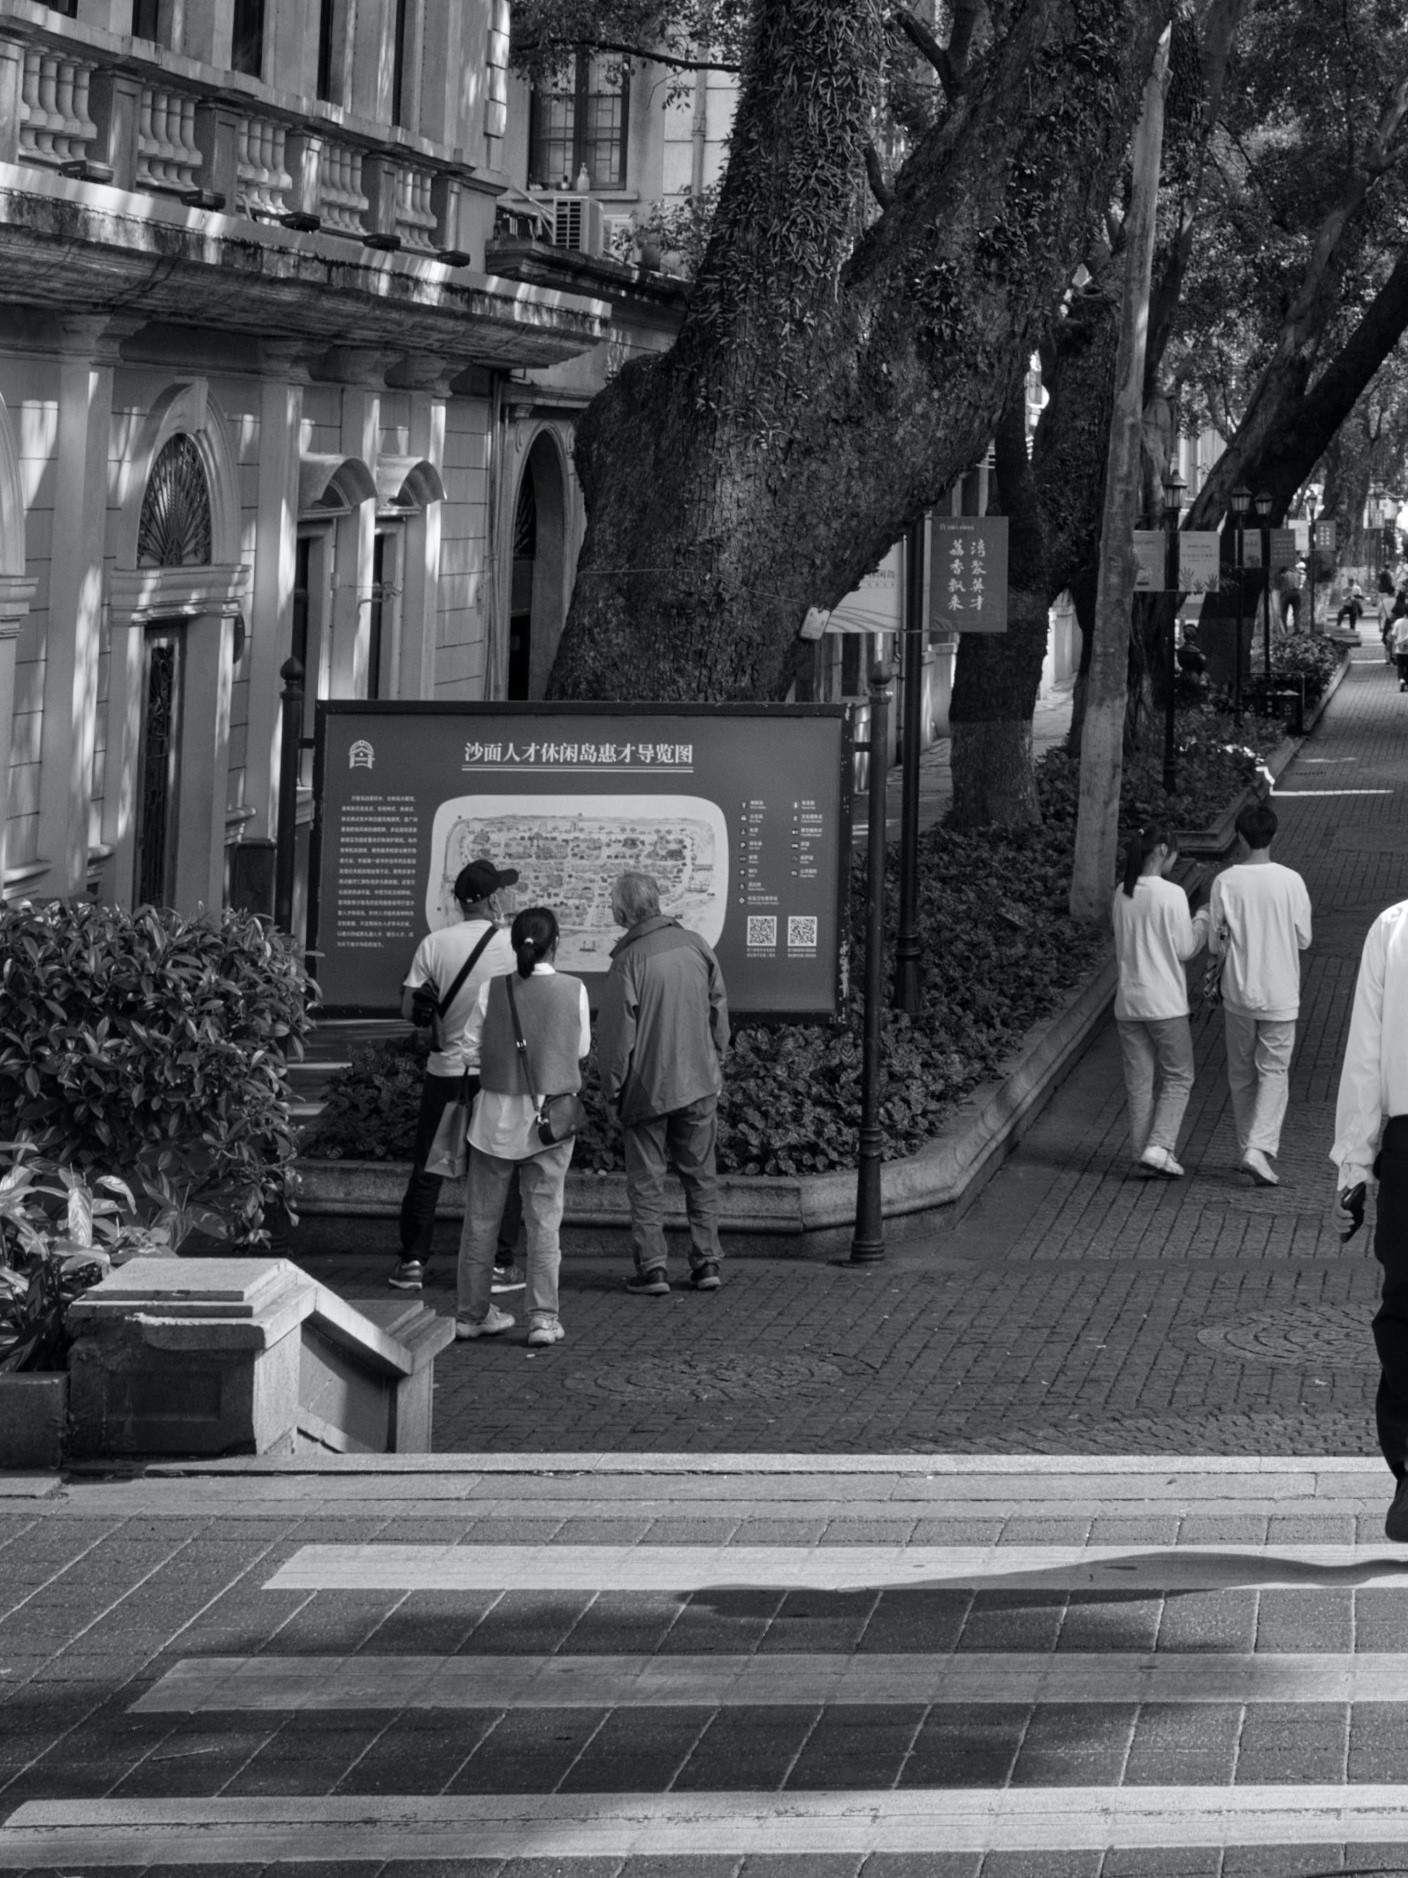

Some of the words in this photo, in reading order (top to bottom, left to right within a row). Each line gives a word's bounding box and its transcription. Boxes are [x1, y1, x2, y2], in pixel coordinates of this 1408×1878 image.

[464, 741, 694, 764] 沙面人才休闲岛惠才导览图
